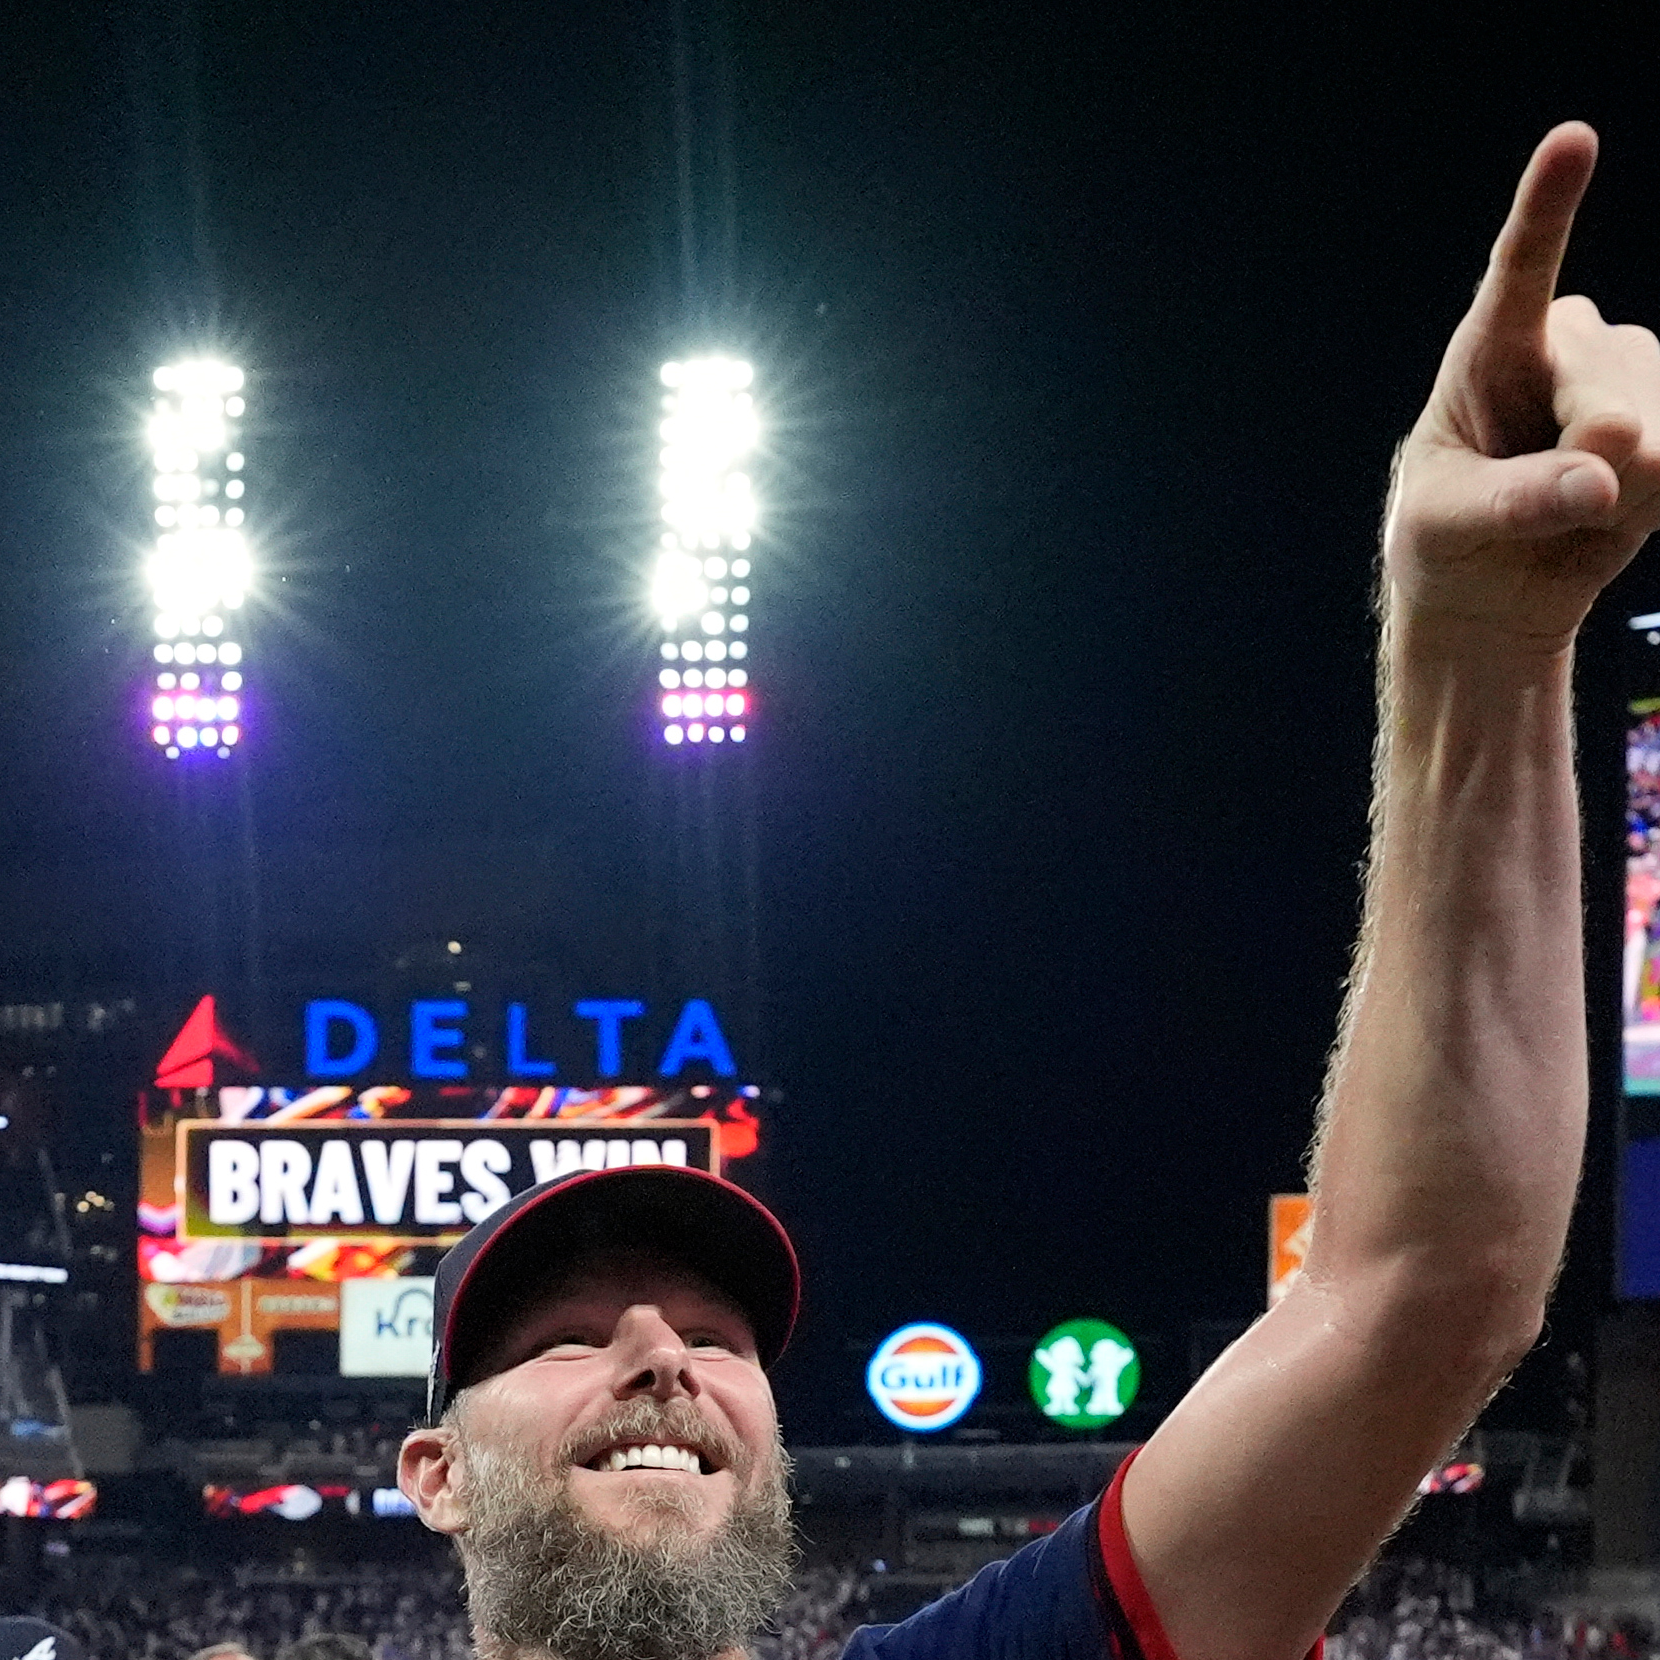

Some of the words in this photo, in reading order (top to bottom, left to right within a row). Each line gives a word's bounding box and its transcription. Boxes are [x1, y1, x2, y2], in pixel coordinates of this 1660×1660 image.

[305, 999, 737, 1077] DELTA
[209, 1139, 512, 1224] BRAVES
[880, 1362, 964, 1390] Gulf
